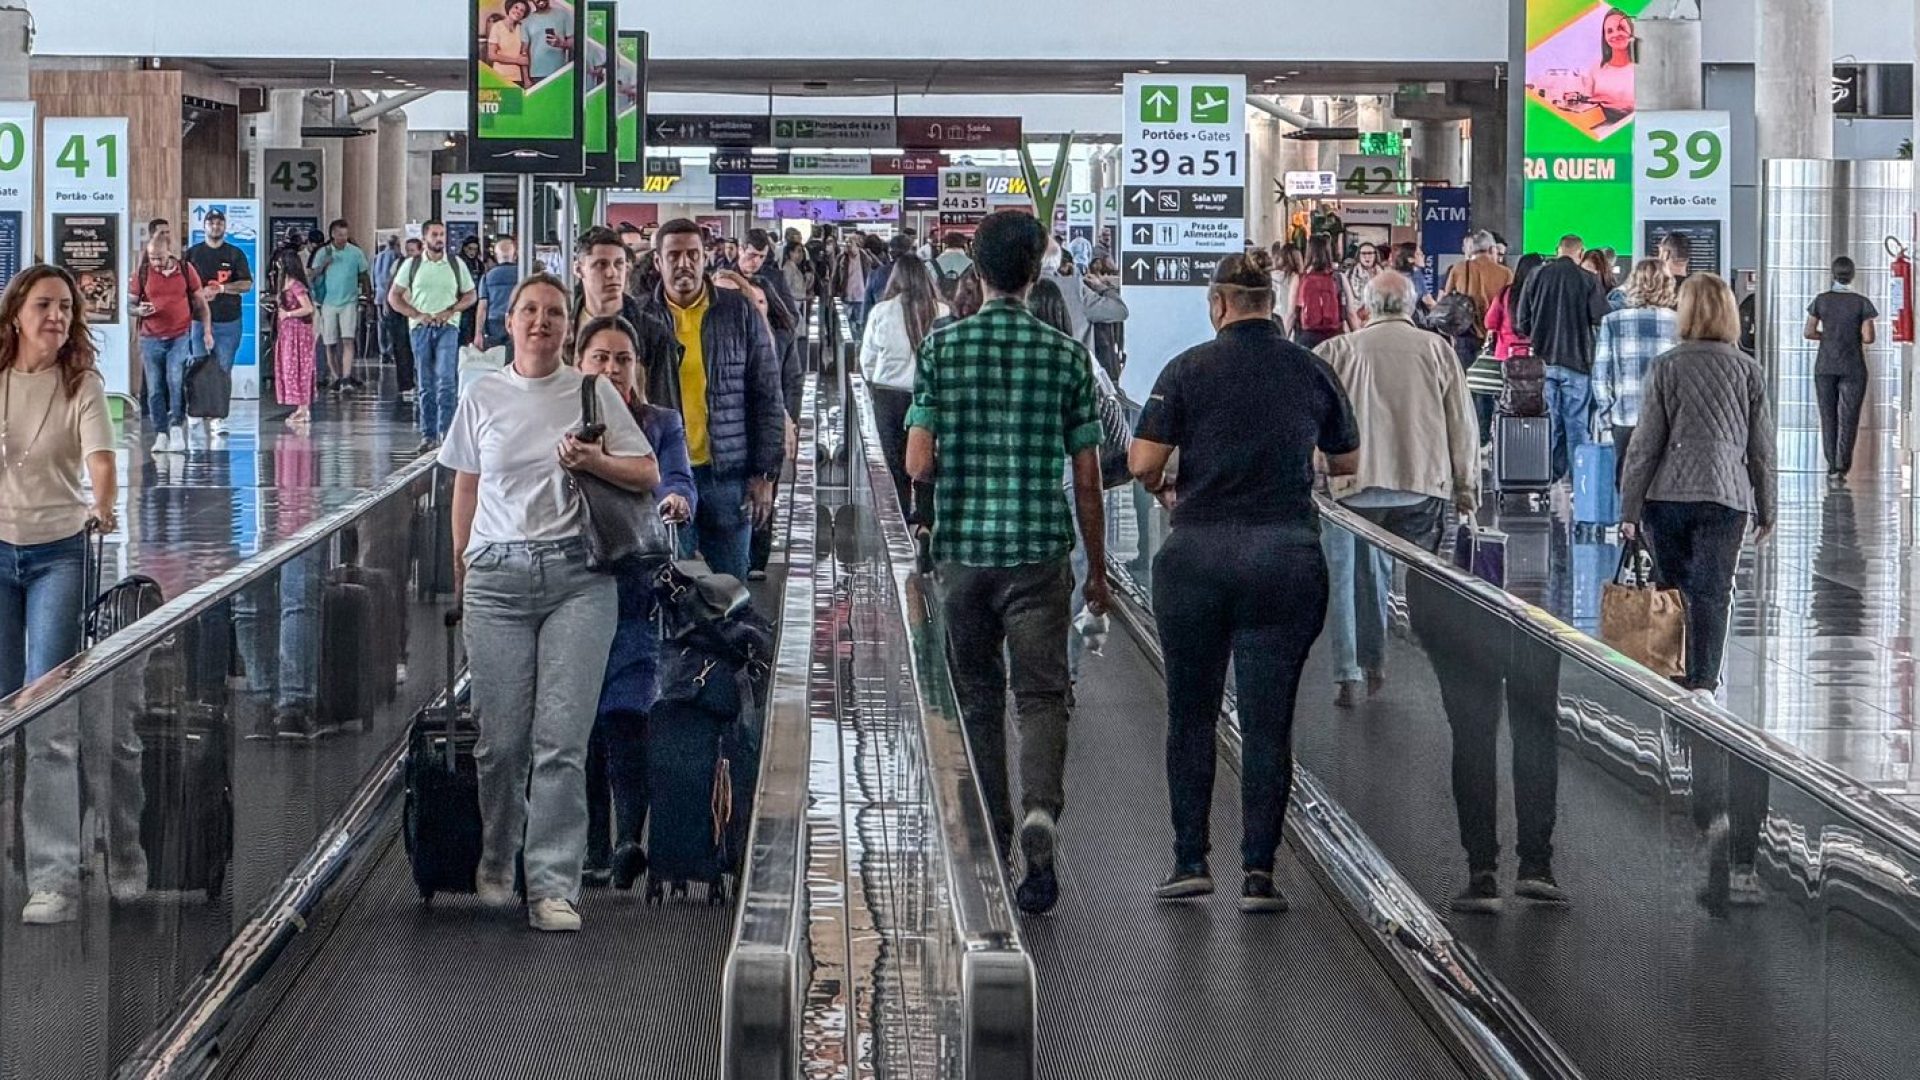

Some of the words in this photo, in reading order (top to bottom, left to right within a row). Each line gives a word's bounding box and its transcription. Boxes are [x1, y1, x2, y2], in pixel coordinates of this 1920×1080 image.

[1142, 129, 1189, 141] Portões
[1198, 130, 1231, 142] Gates
[56, 134, 117, 178] 41
[1130, 148, 1170, 175] 39
[1178, 155, 1195, 175] a
[1202, 149, 1237, 176] 51
[1646, 130, 1722, 179] 39
[270, 161, 318, 192] 43
[1553, 157, 1616, 181] QUEM
[1345, 166, 1393, 194] 42
[0, 187, 18, 198] ate
[92, 191, 114, 201] Gate
[446, 182, 479, 205] 45
[1191, 192, 1211, 202] Sala
[1211, 193, 1228, 203] VIP
[943, 197, 962, 209] 44
[1070, 199, 1093, 214] 50
[1650, 195, 1686, 206] Portão
[1692, 196, 1717, 206] Gate
[1425, 207, 1466, 221] ATM
